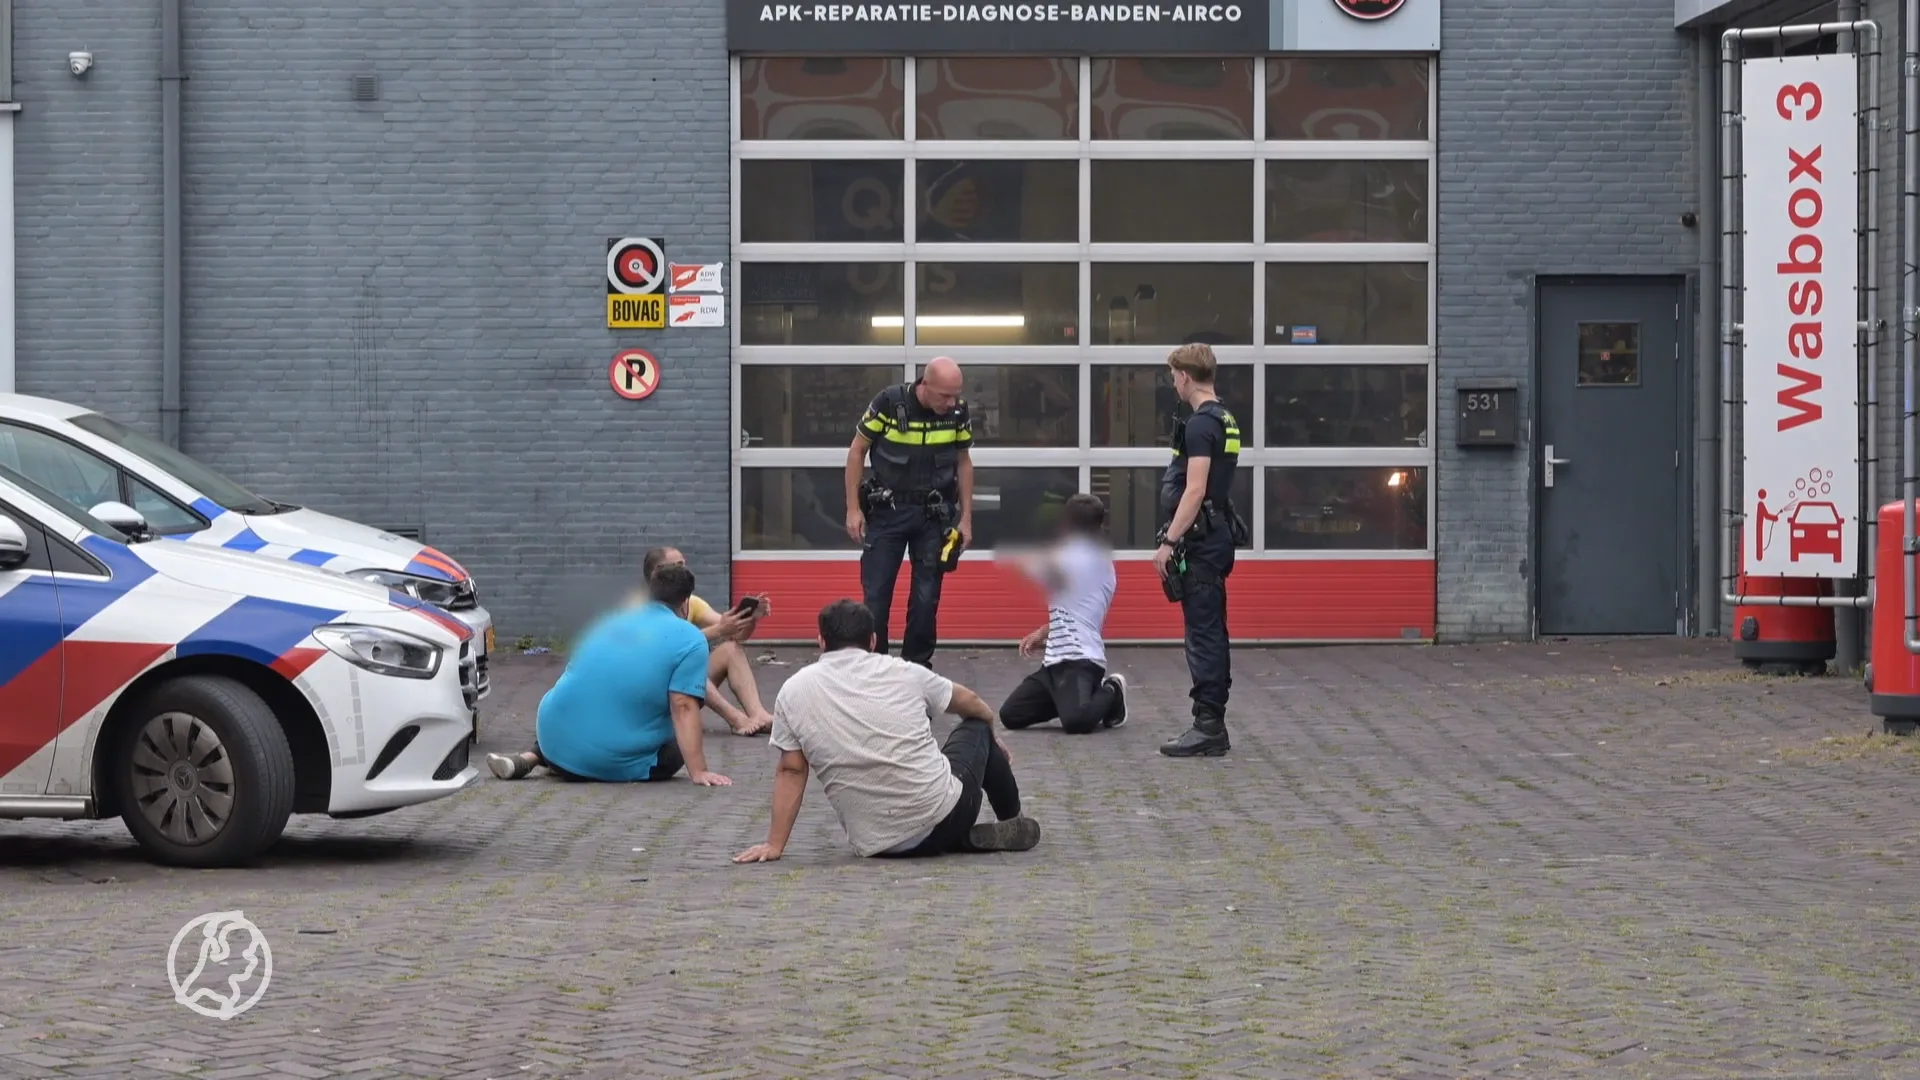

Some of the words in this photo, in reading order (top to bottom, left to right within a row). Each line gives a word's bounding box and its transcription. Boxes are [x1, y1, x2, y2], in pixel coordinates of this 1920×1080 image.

[759, 4, 1242, 22] APK-REPARATIE-DIAGNOSE-BANDEN-AIRCO
[1776, 80, 1824, 121] 3
[1776, 143, 1824, 433] Wasbox
[612, 299, 660, 322] BOVAG
[700, 306, 718, 315] RDW
[625, 358, 646, 390] P
[1467, 393, 1499, 410] 531
